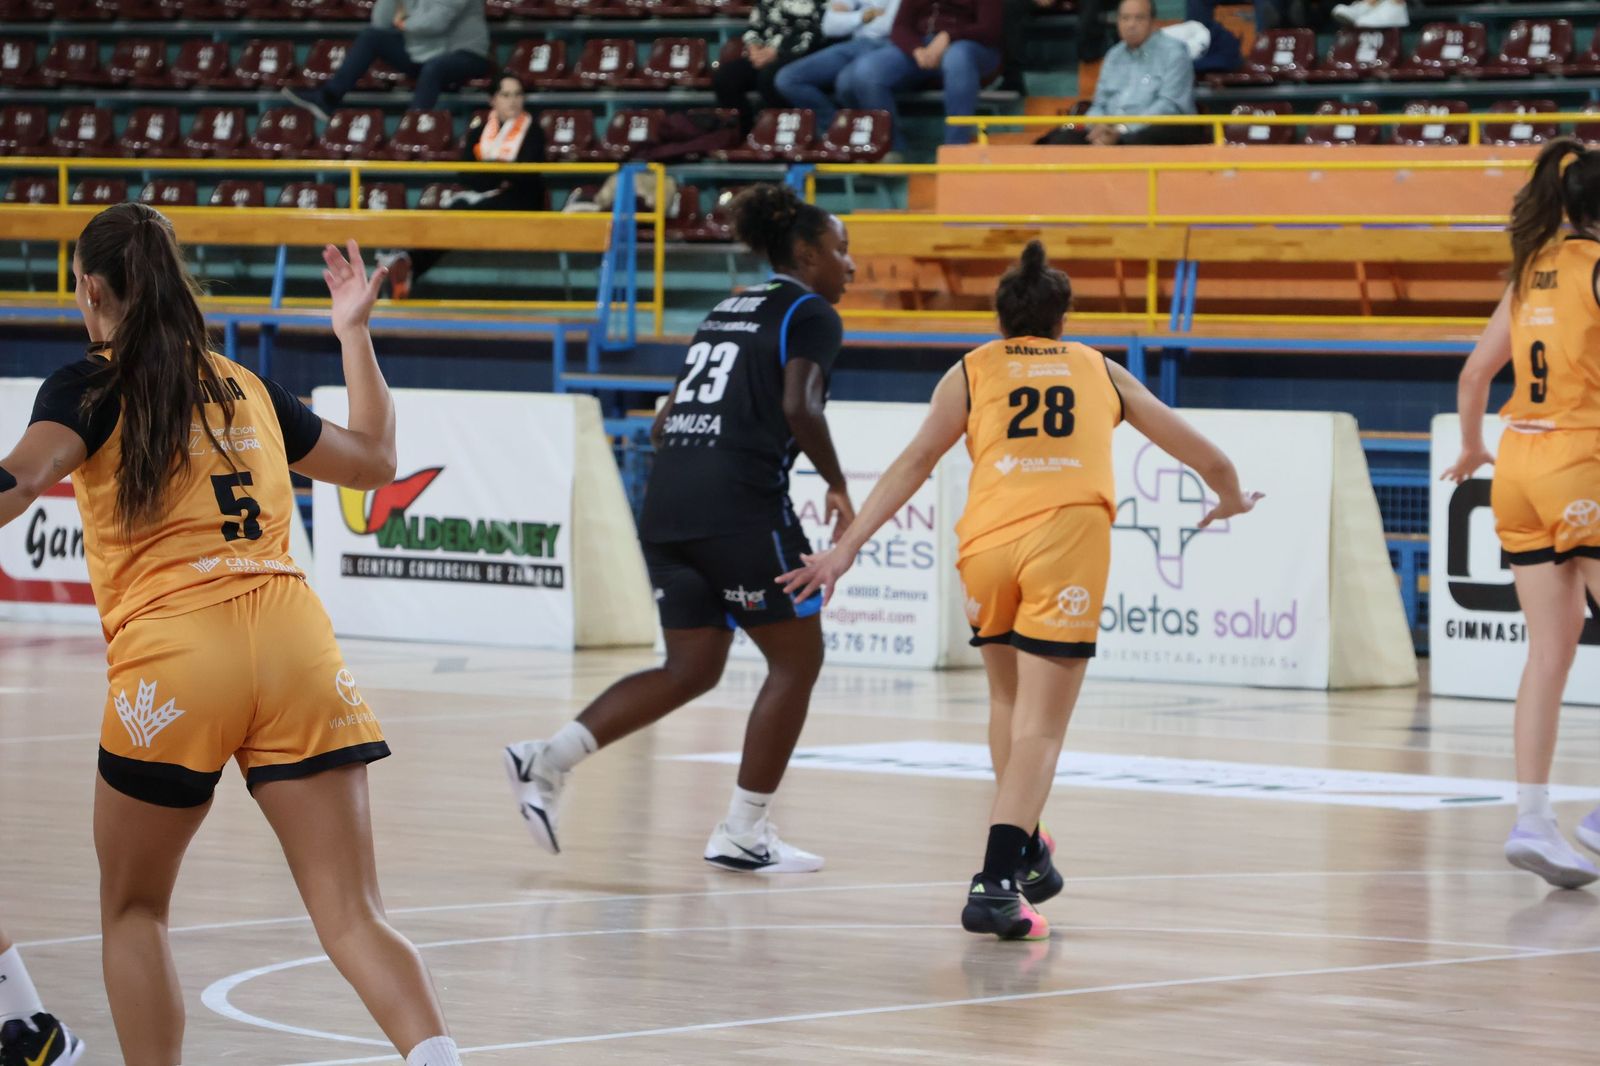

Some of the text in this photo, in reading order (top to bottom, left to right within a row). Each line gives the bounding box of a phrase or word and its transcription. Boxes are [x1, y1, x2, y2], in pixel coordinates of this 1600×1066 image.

[674, 341, 740, 404] 23
[1530, 340, 1548, 404] 9
[1007, 385, 1075, 439] 28
[210, 471, 263, 542] 5
[375, 508, 562, 558] VALDERADUEY
[26, 507, 85, 569] Gan
[357, 558, 404, 577] CENTRO
[408, 562, 481, 581] COMERCIAL
[486, 566, 503, 582] DE
[507, 567, 563, 586] ZAMORA
[1100, 593, 1297, 640] oletas salud
[1446, 619, 1527, 643] GIMNASI
